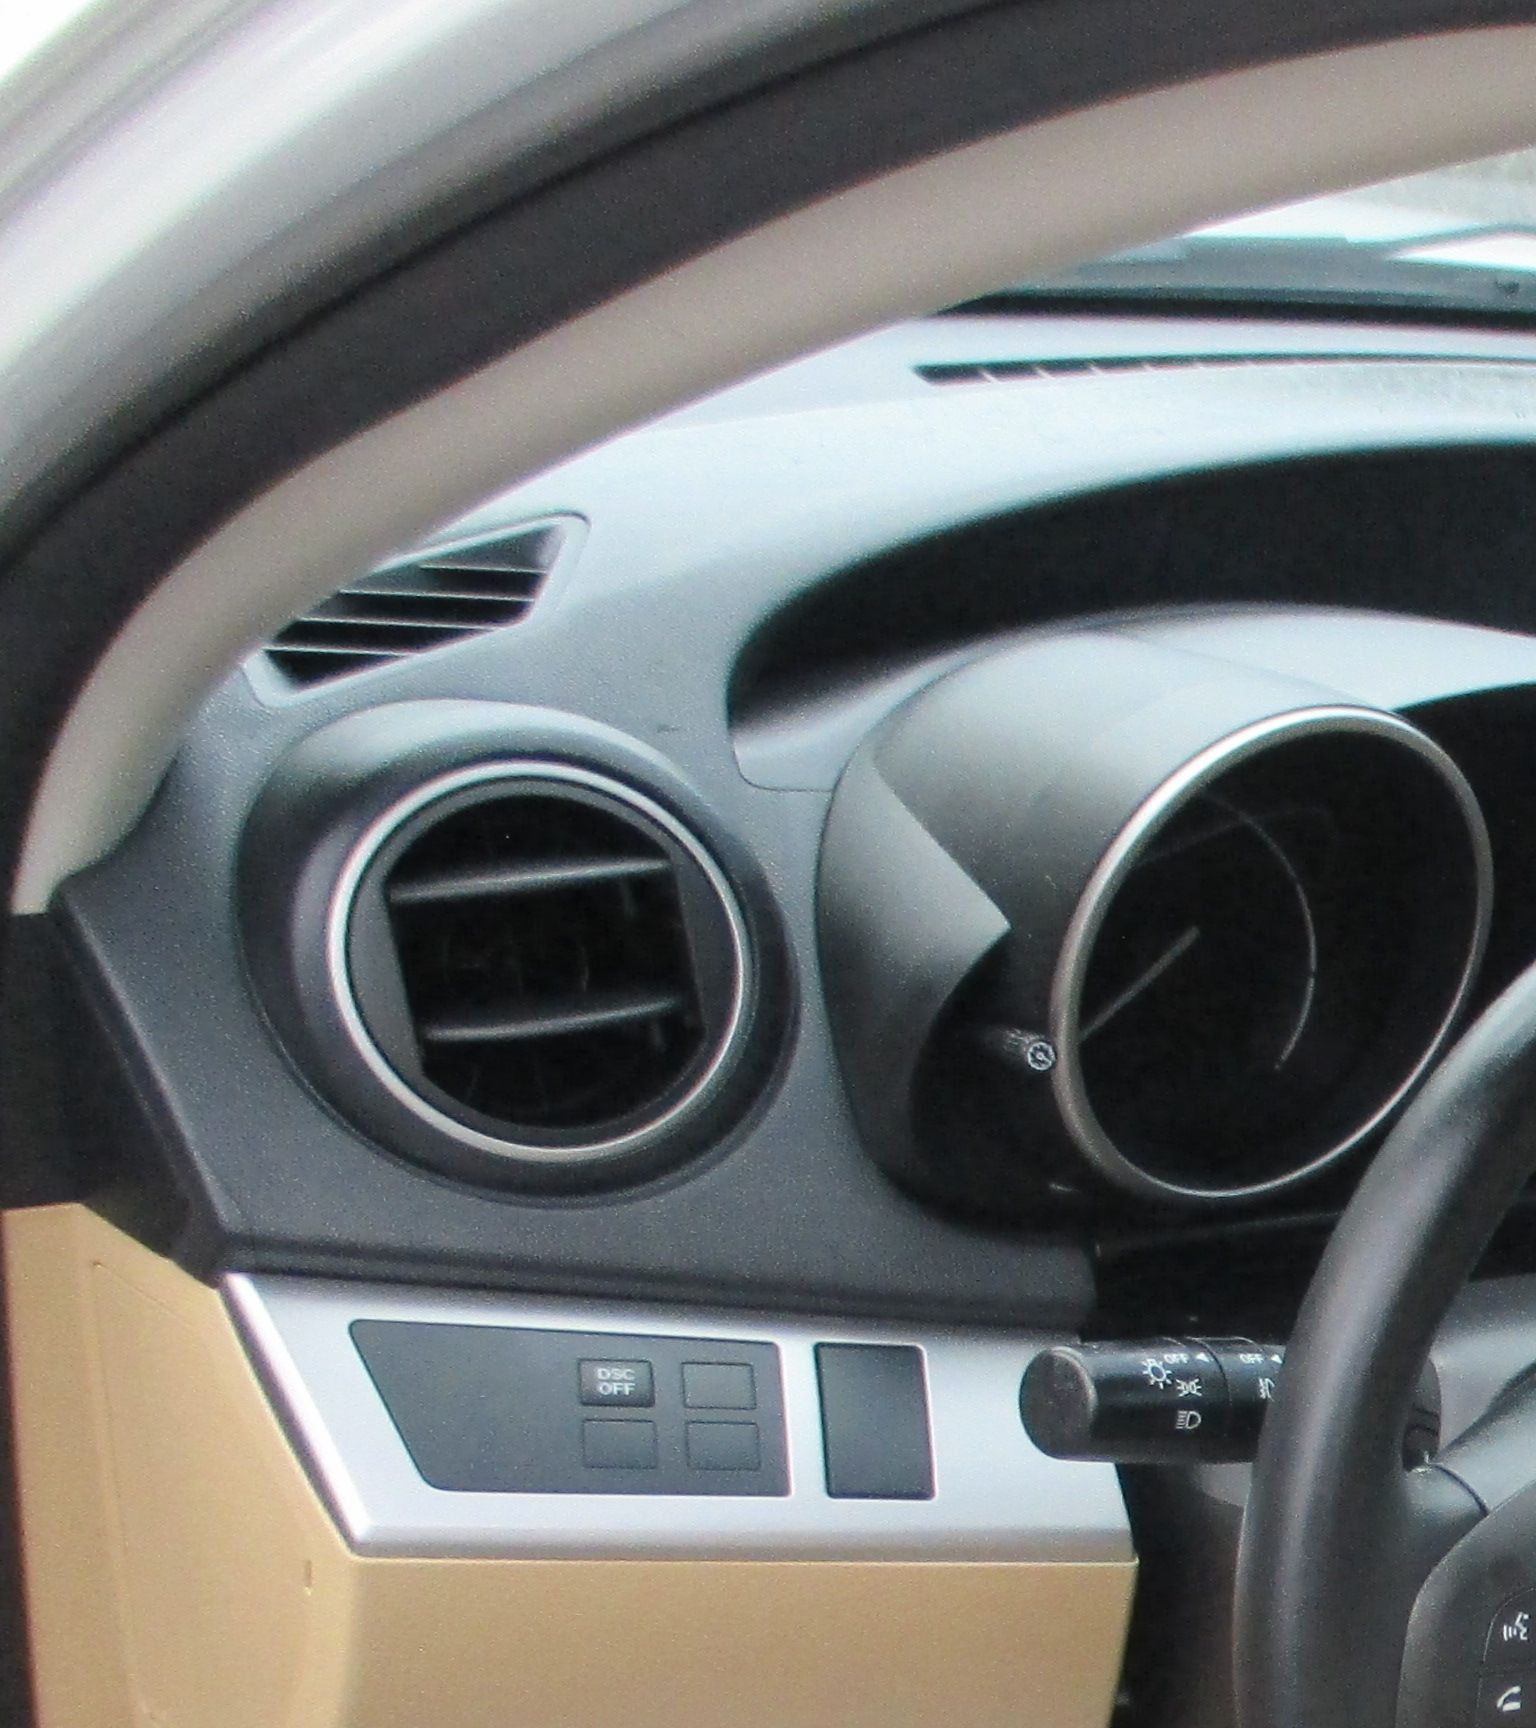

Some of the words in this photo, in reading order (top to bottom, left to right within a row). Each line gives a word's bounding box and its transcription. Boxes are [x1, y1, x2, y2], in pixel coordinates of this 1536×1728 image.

[1163, 1352, 1189, 1364] OFF
[1239, 1352, 1265, 1364] OFF
[597, 1367, 636, 1381] DSC
[599, 1382, 636, 1396] OFF
